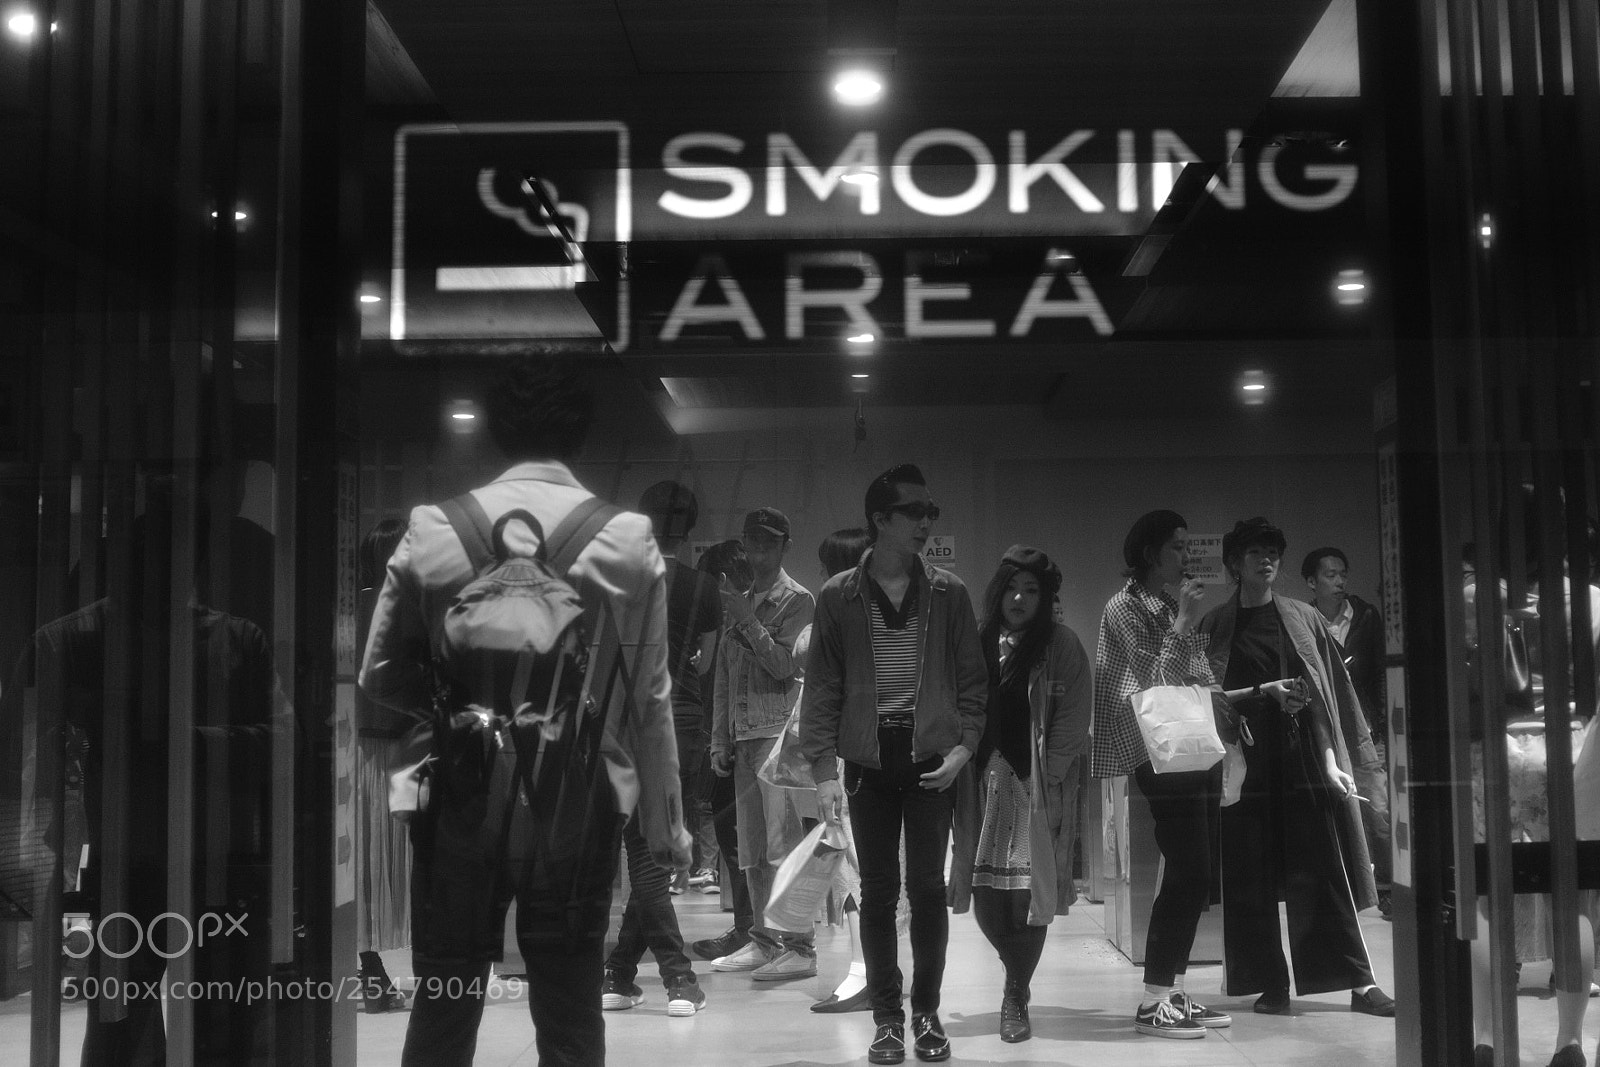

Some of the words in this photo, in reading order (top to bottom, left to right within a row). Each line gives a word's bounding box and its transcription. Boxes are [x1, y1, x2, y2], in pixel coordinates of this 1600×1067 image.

[657, 129, 1360, 217] SMOKING
[659, 250, 1115, 340] AREA
[926, 547, 952, 557] AED
